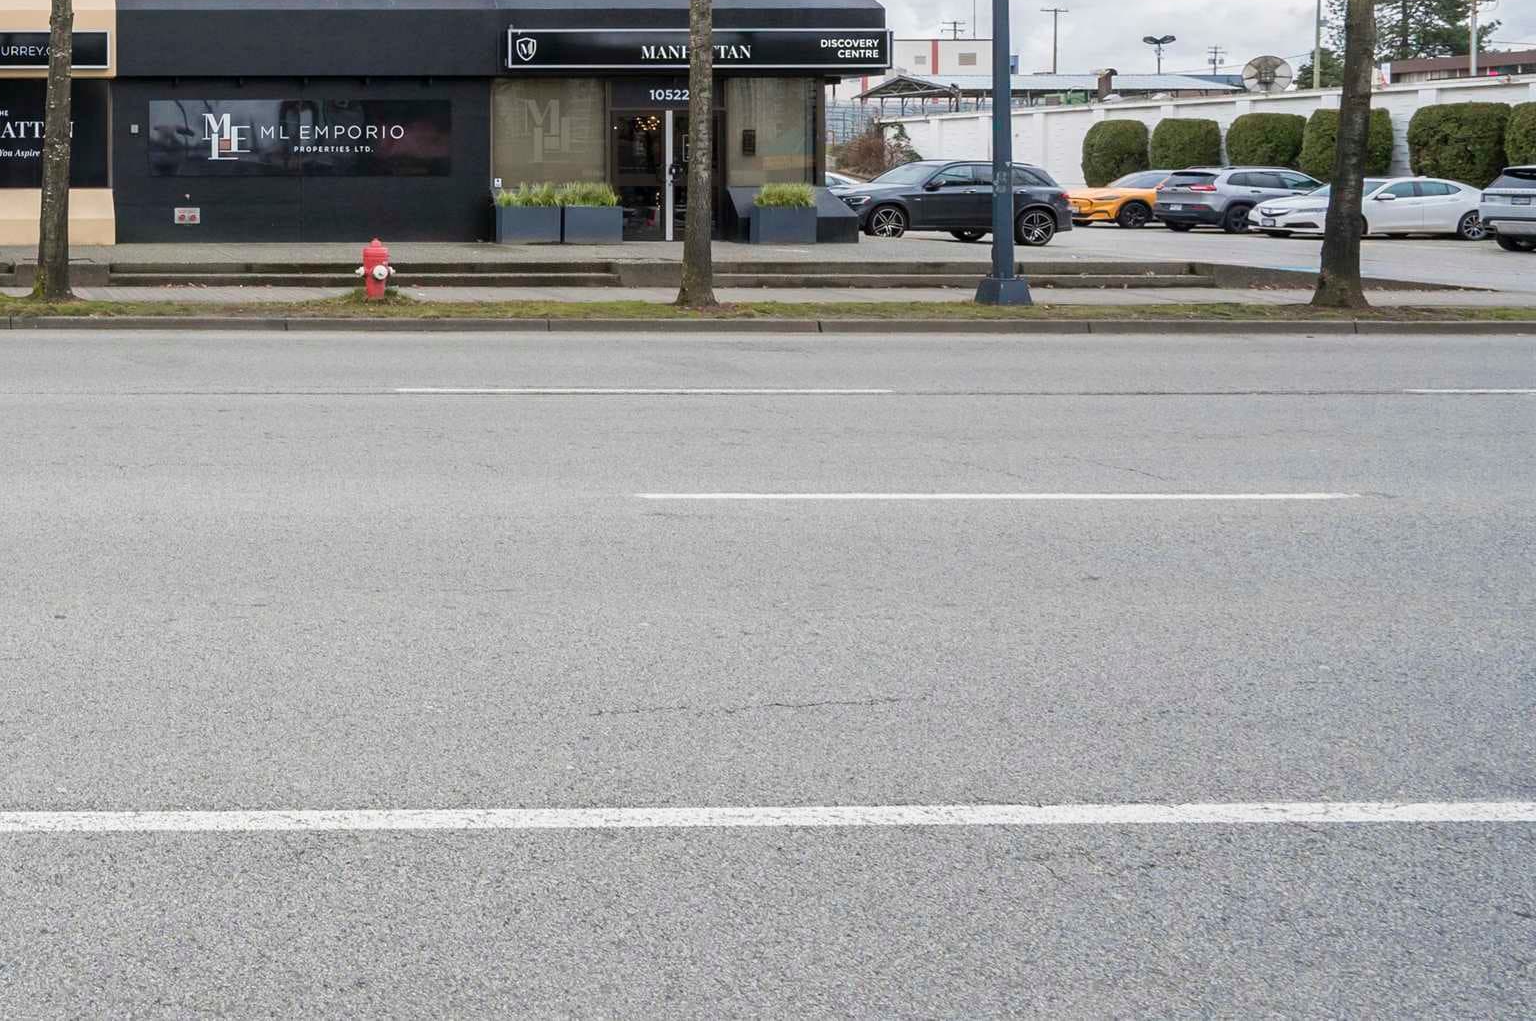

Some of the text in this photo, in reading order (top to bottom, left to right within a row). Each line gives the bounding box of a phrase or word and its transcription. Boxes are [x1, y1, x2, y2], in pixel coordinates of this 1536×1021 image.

[820, 39, 879, 48] DISCOVERY
[837, 49, 879, 58] CENTRE
[649, 89, 690, 101] 10522
[260, 125, 405, 140] ML EMPORIO
[294, 145, 374, 153] PROPERTIES LTD.
[14, 149, 41, 159] Aspire
